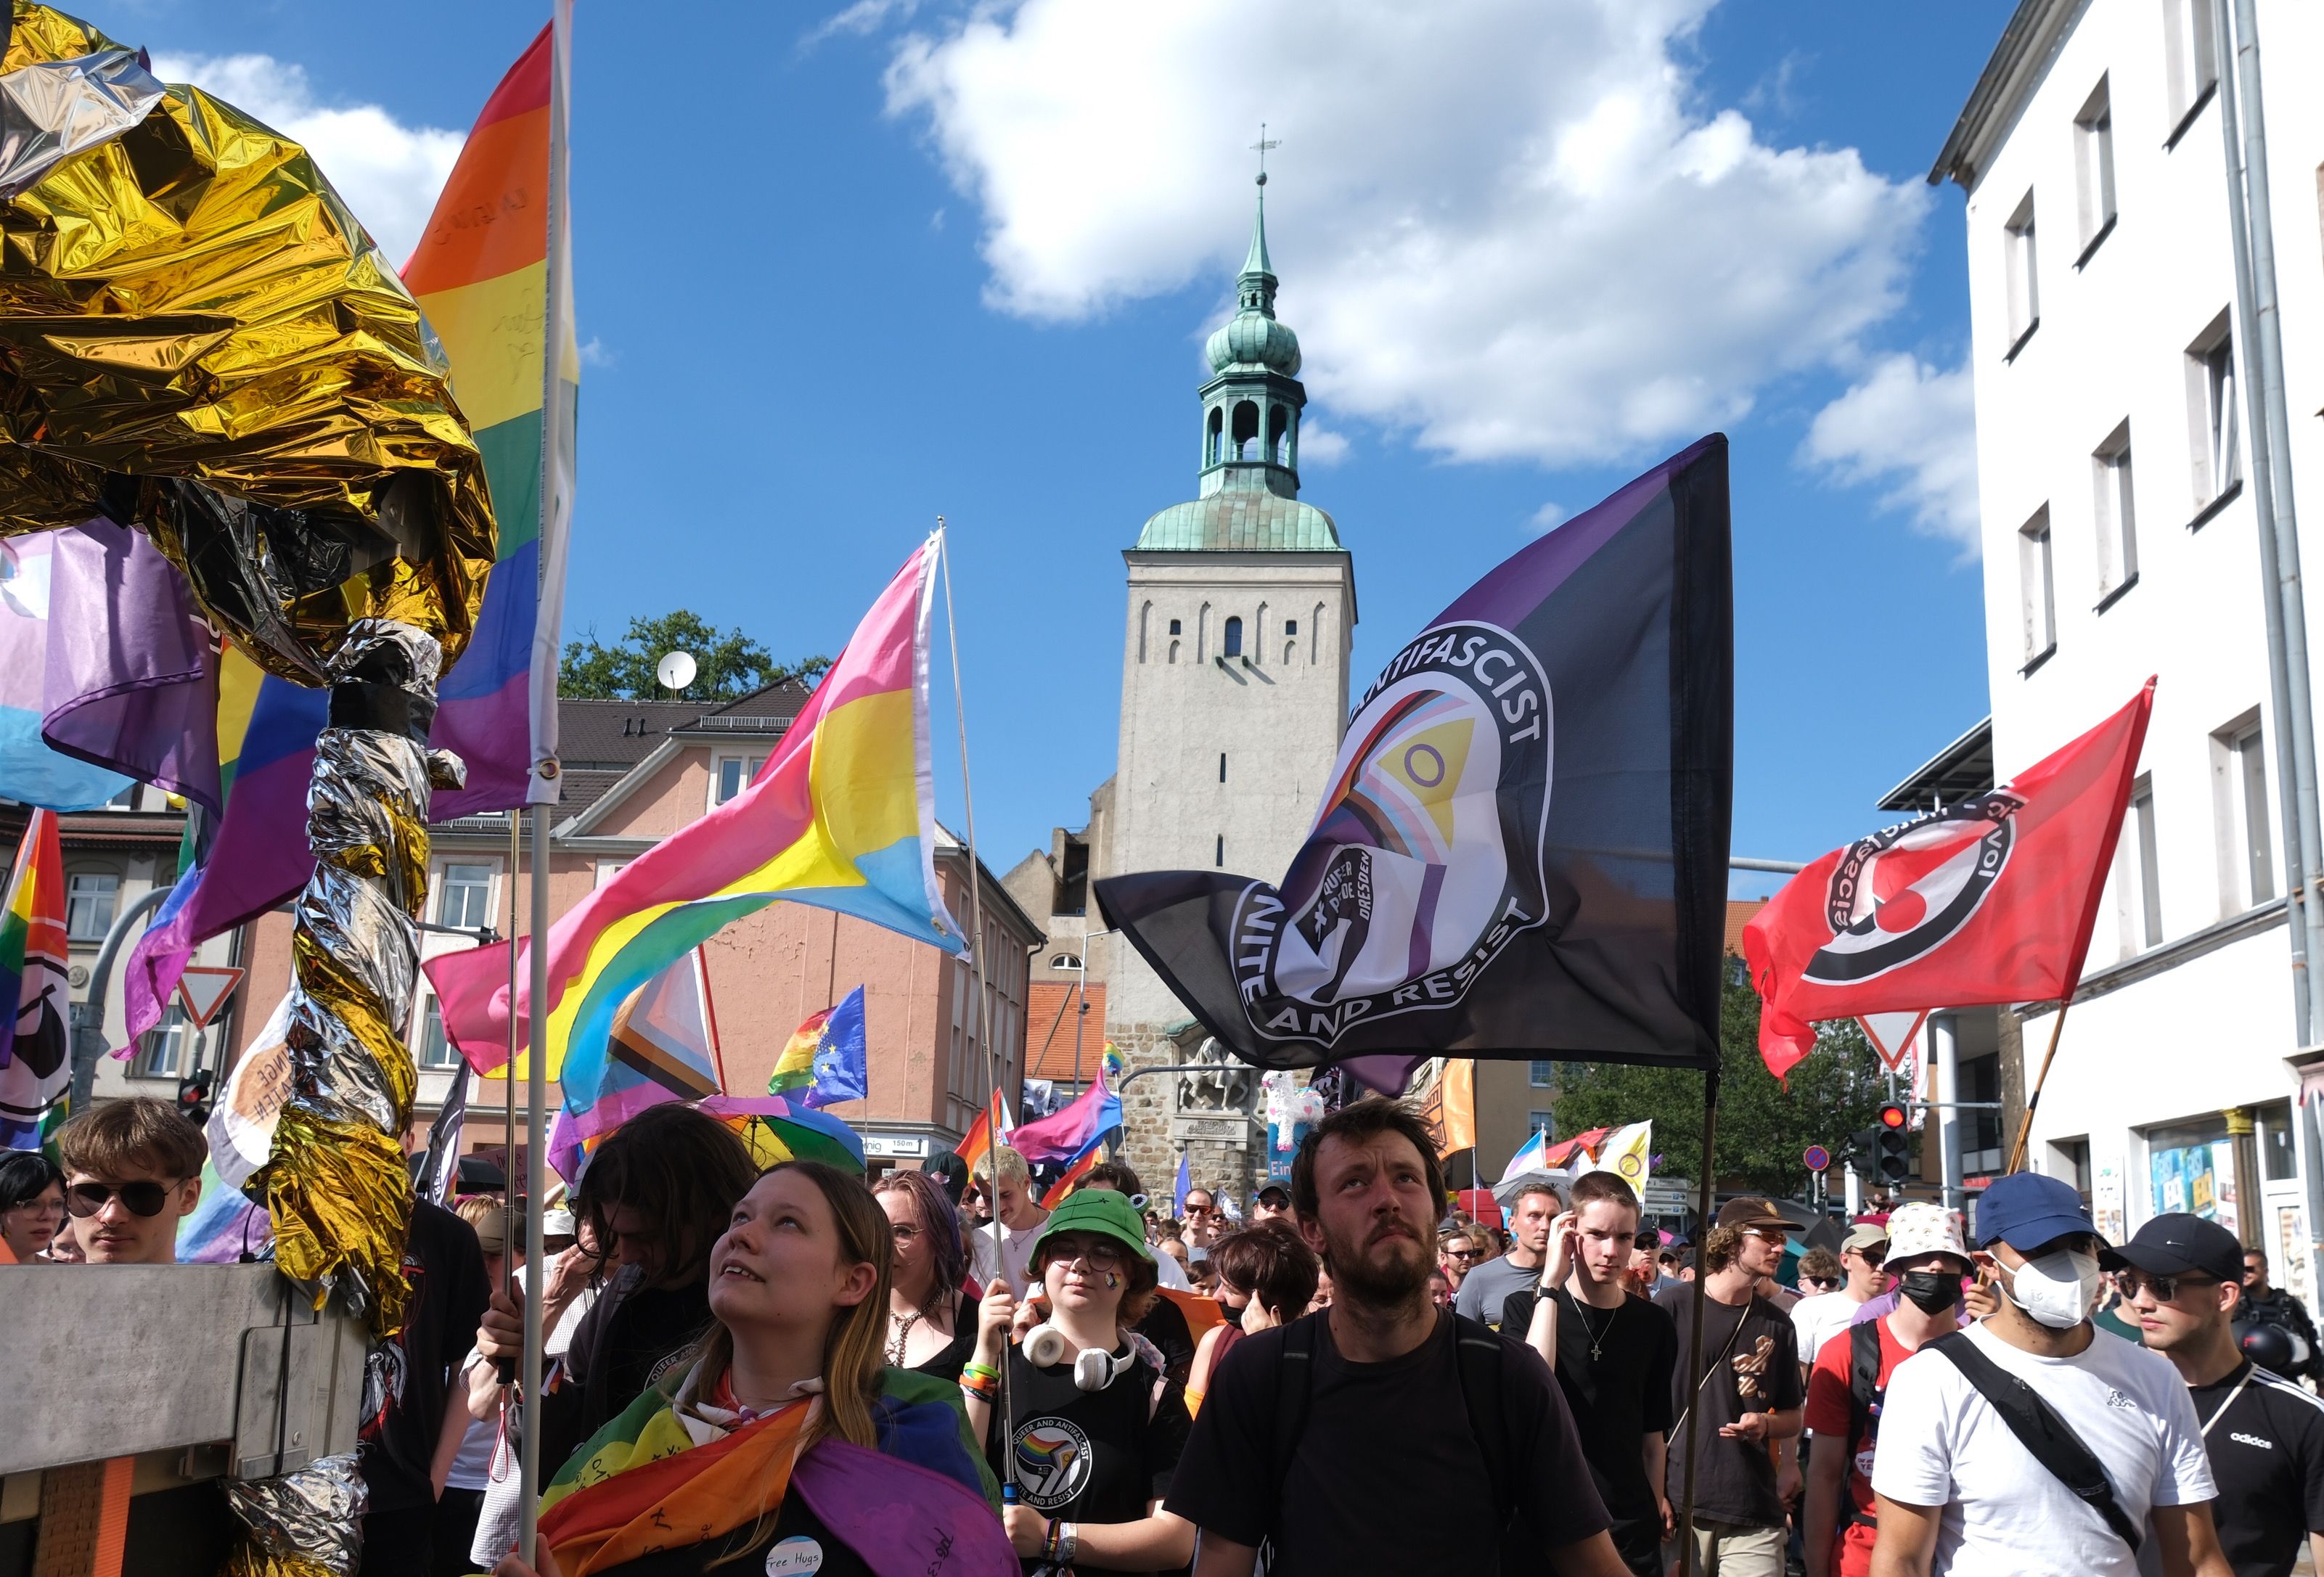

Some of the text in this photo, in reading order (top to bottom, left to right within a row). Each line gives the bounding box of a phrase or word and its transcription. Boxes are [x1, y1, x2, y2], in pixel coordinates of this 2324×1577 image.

[1349, 634, 1540, 744] ANTIFASCIST
[1329, 882, 1356, 914] PDE
[1357, 851, 1371, 921] DRESDEN
[1239, 885, 1531, 1038] NITE AND RESIST
[651, 1356, 678, 1382] QUEER
[1012, 1420, 1089, 1461] QUEER AND ANTIFASCIST
[2230, 1432, 2272, 1449] adidas
[1028, 1492, 1045, 1506] AND
[1048, 1488, 1075, 1506] RESIST
[766, 1552, 819, 1568] Free Hugs
